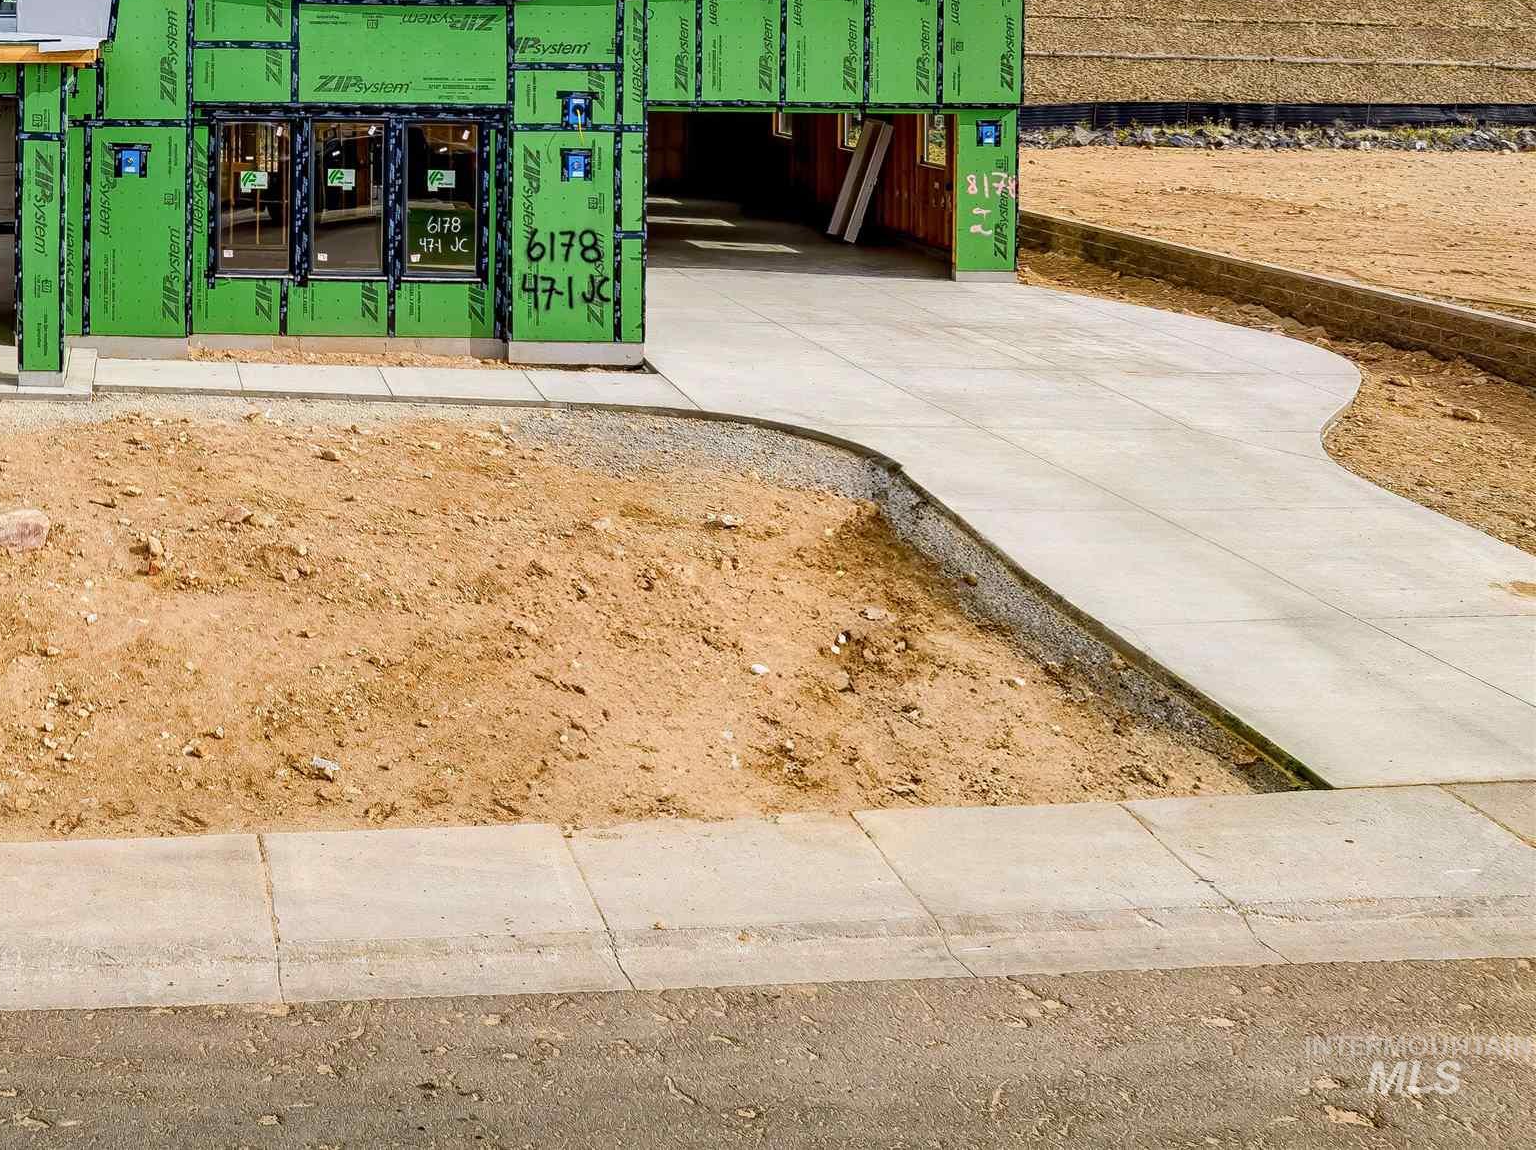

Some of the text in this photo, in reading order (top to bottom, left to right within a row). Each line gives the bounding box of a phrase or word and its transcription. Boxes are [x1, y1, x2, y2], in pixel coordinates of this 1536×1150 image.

[515, 36, 591, 55] IPsystem
[313, 74, 412, 95] ZIPsystem
[427, 216, 462, 234] 6178
[450, 236, 470, 252] JC
[527, 228, 602, 263] 6178
[581, 273, 612, 303] JC
